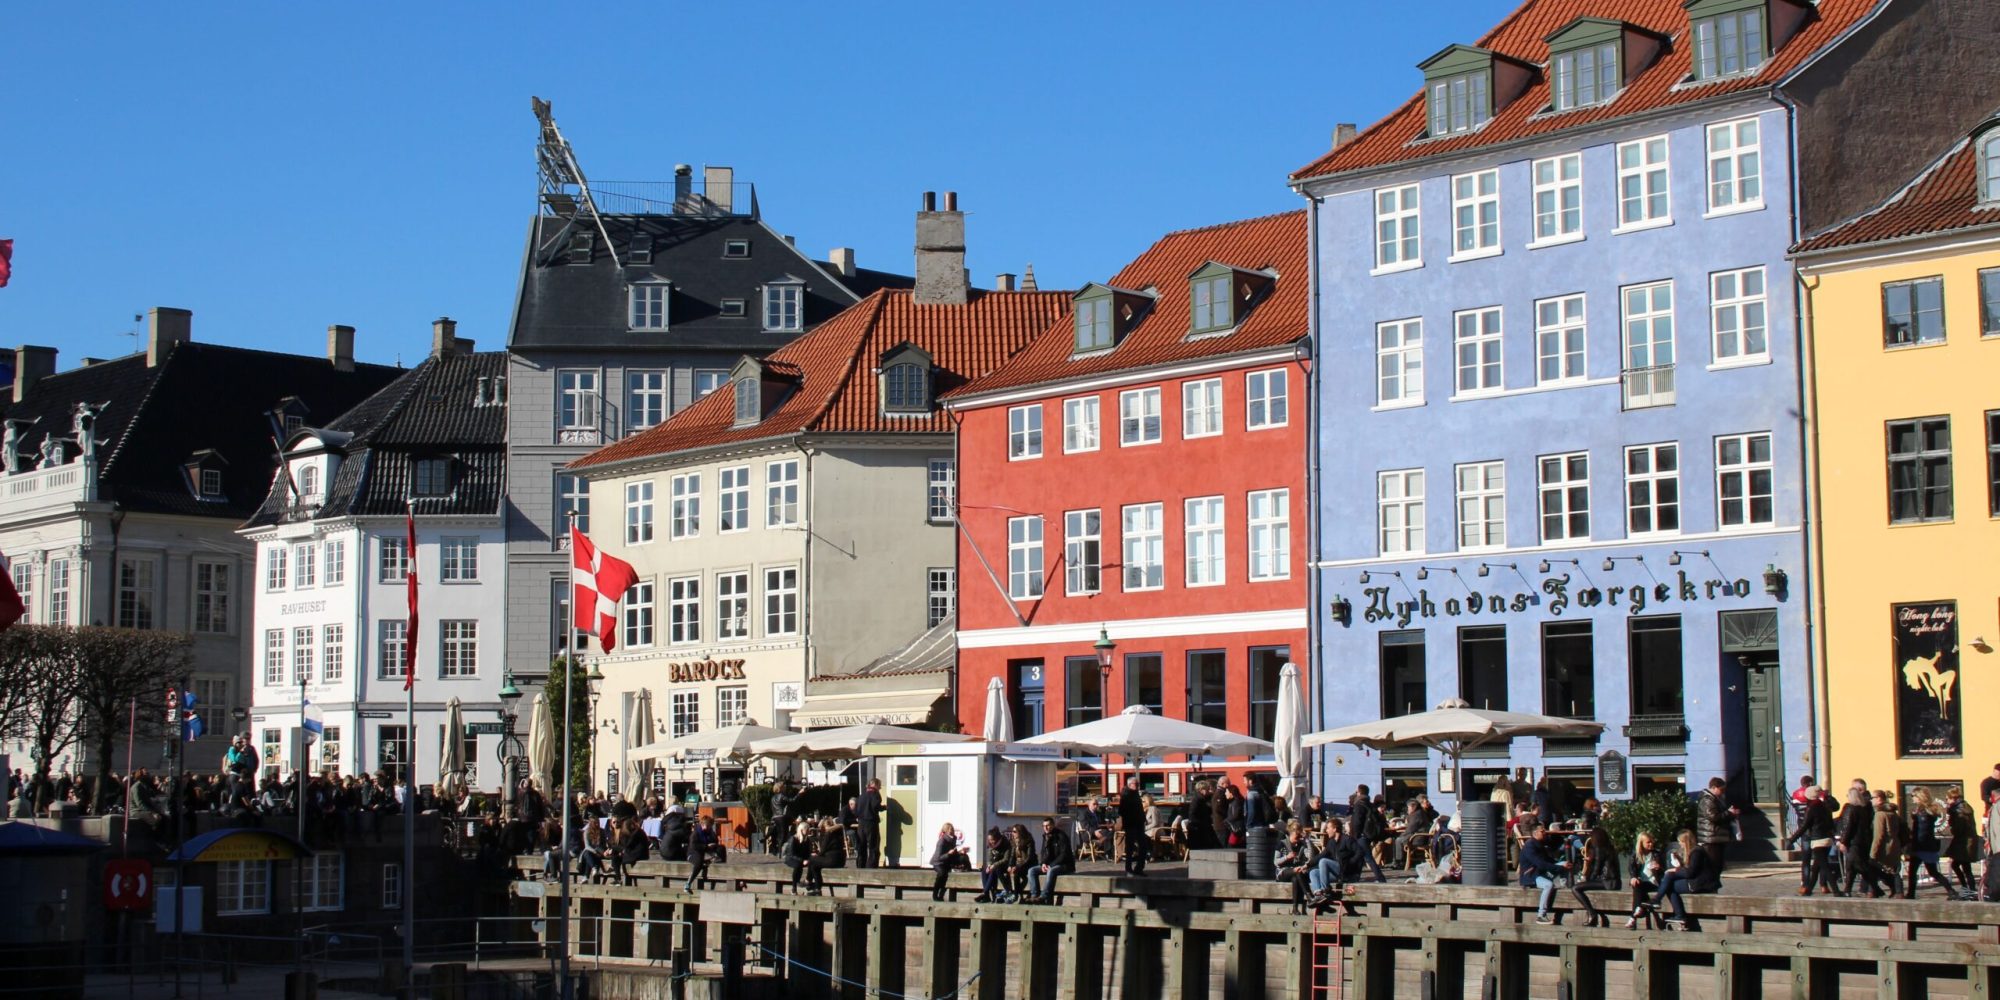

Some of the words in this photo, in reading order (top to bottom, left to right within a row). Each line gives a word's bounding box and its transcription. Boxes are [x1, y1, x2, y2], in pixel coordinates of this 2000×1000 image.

[281, 600, 327, 615] RAVHUSET
[1363, 587, 1529, 628] Nyhavns
[1542, 573, 1750, 615] Færgekro
[1899, 607, 1929, 627] Hong
[668, 659, 746, 683] BAROCK
[1031, 666, 1041, 680] 3
[810, 714, 870, 727] RESTAURANT
